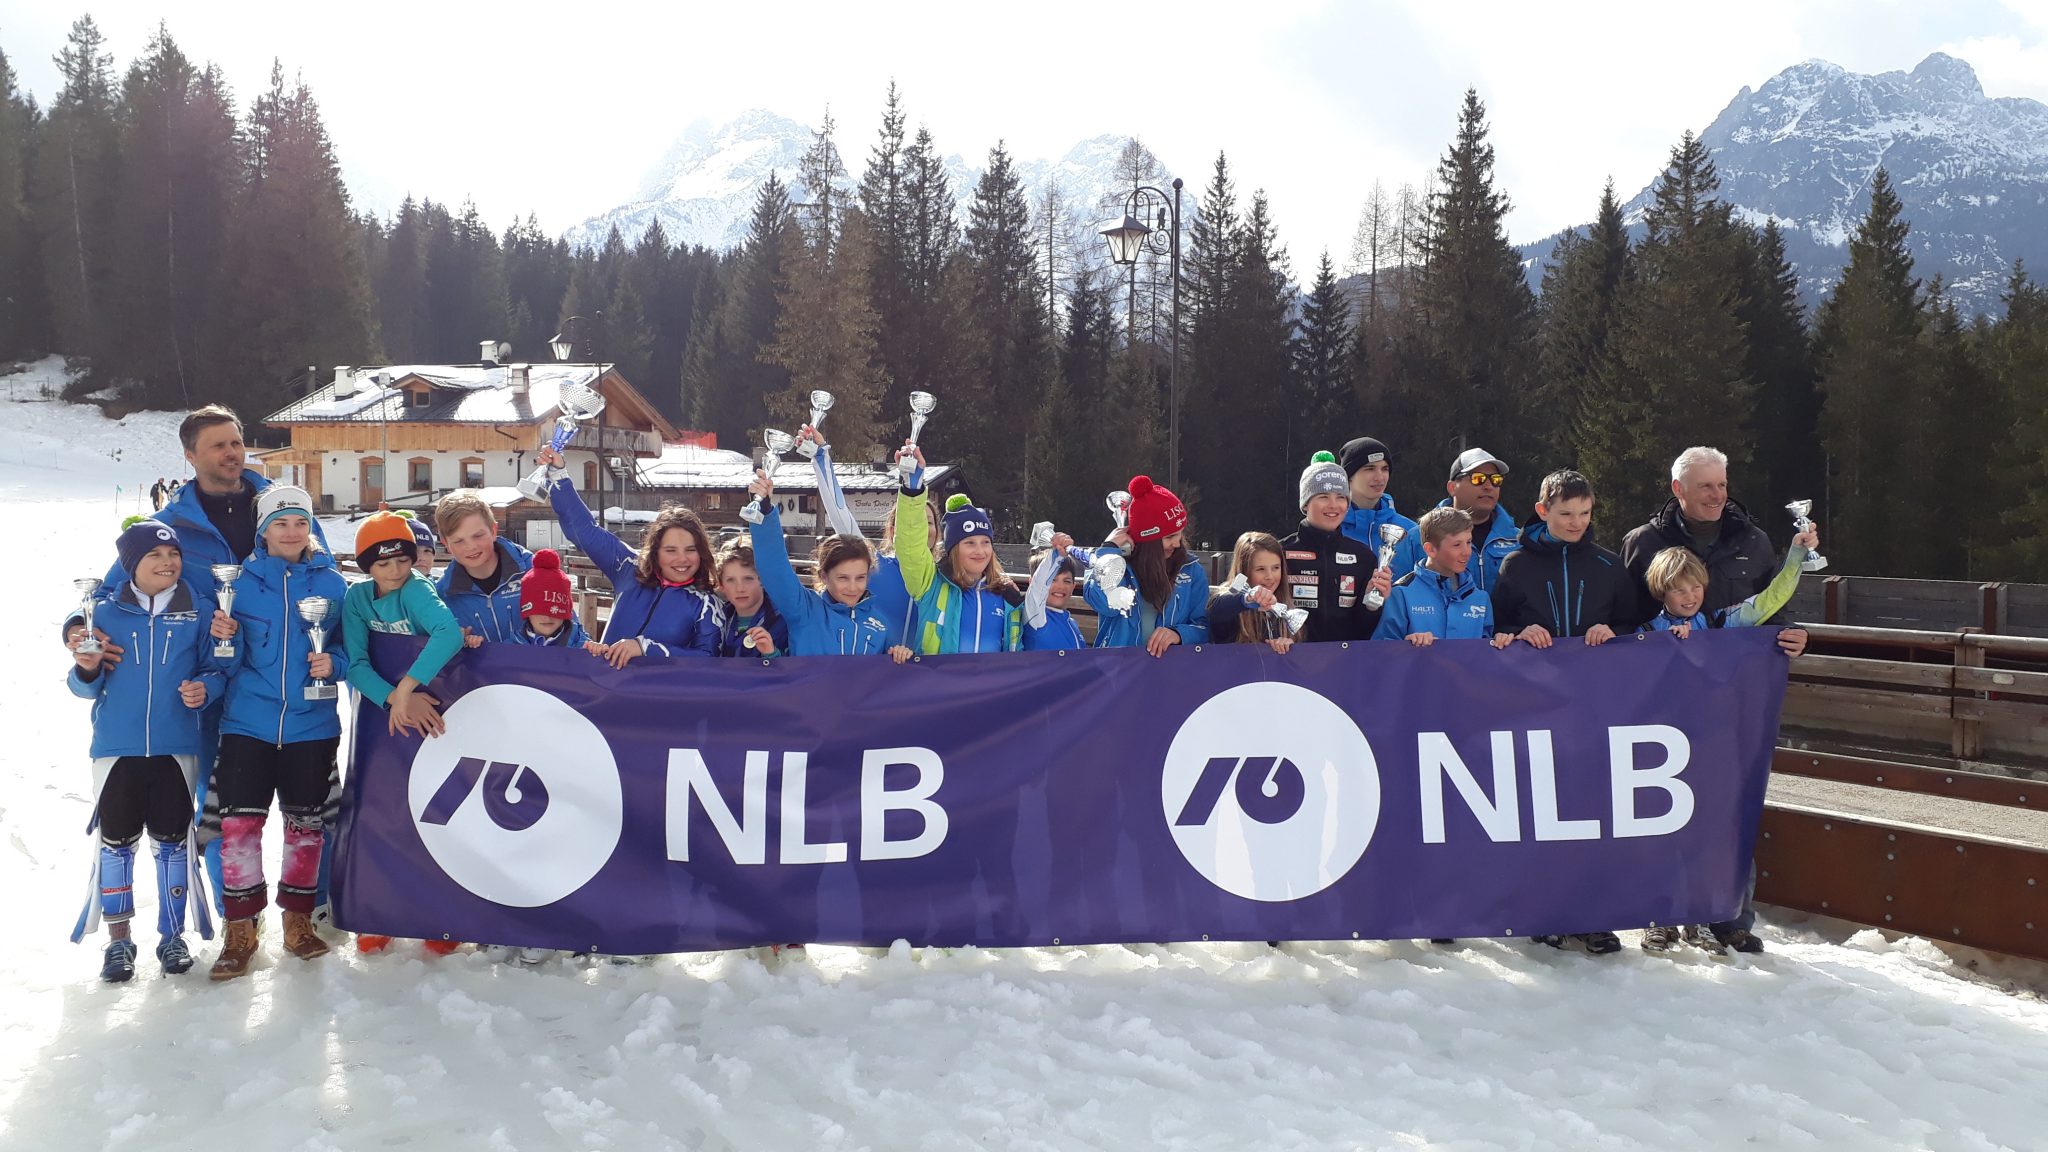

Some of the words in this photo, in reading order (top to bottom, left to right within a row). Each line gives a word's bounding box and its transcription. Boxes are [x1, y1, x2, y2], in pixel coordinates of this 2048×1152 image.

[415, 533, 430, 541] NLB
[975, 521, 989, 530] NLB
[665, 746, 949, 864] NLB
[1417, 724, 1696, 843] NLB
